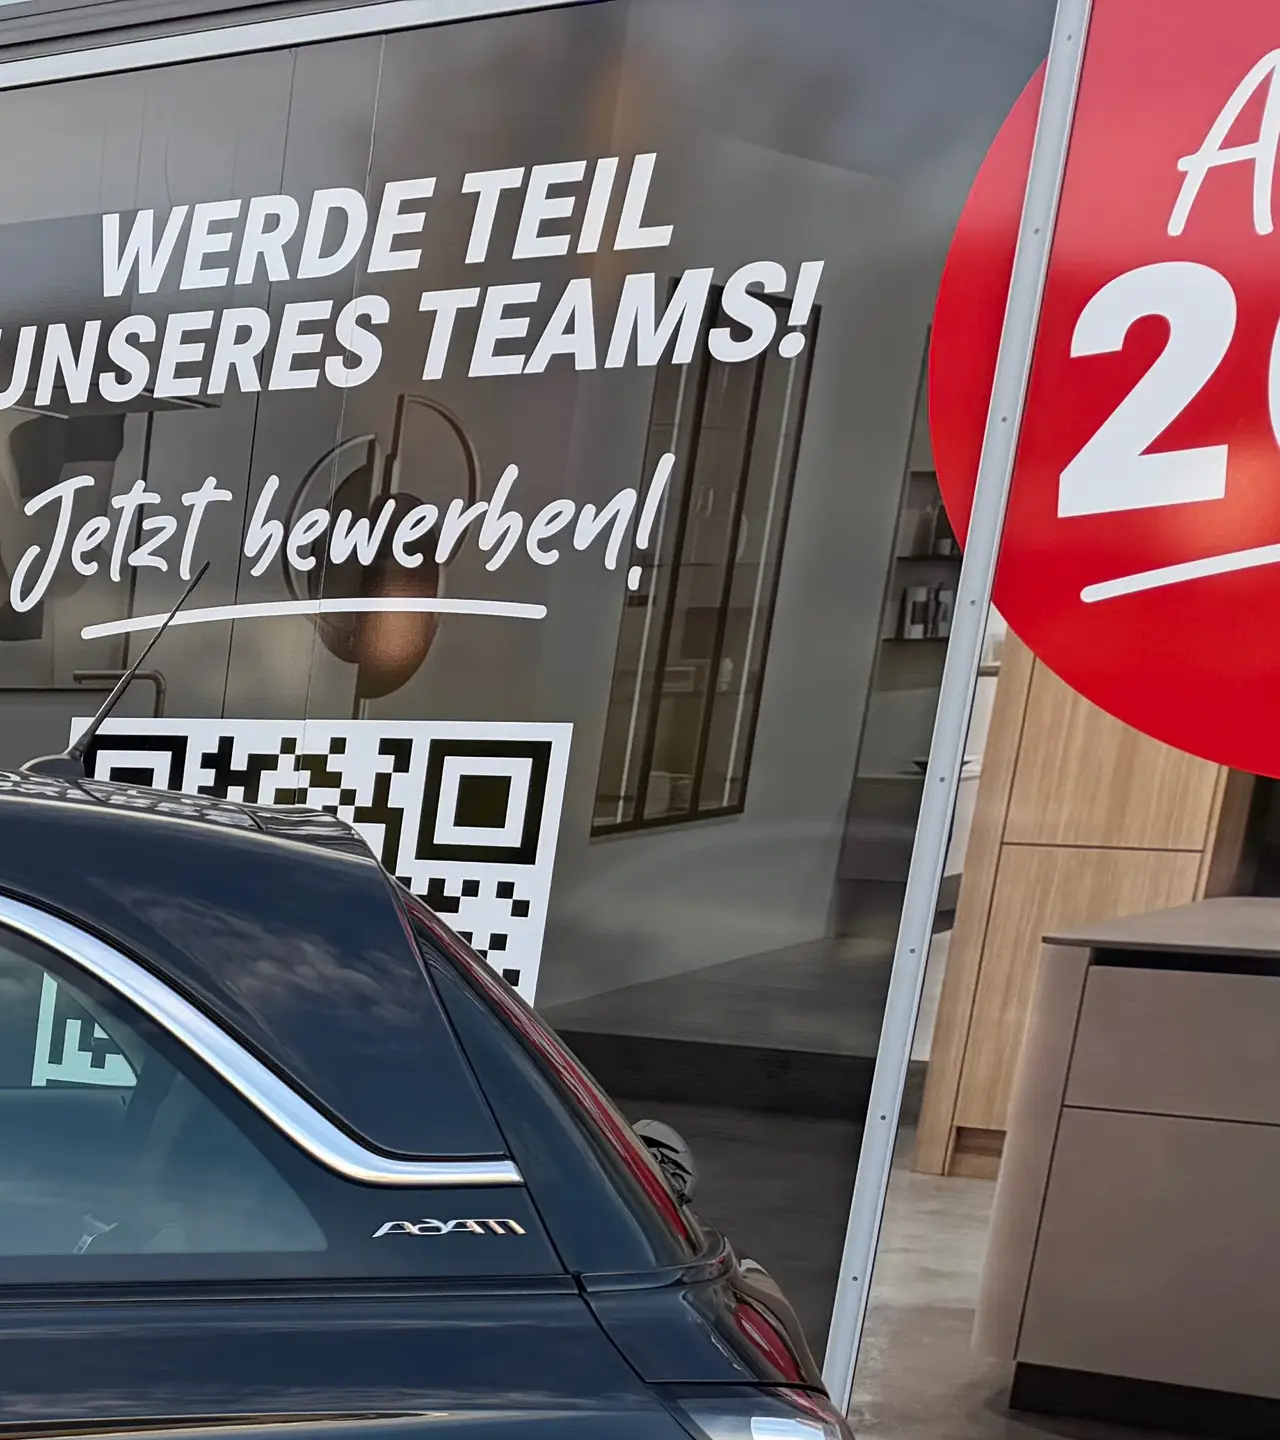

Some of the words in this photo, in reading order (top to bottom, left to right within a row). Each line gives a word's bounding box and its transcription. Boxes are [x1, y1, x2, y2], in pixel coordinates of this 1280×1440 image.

[101, 176, 436, 297] WERDE
[461, 152, 675, 264] TEIL
[418, 260, 825, 381] TEAMS!
[1057, 260, 1280, 518] 2
[9, 473, 232, 613] Jetzt
[243, 451, 676, 592] bewerben!
[371, 1218, 527, 1239] ADAM
